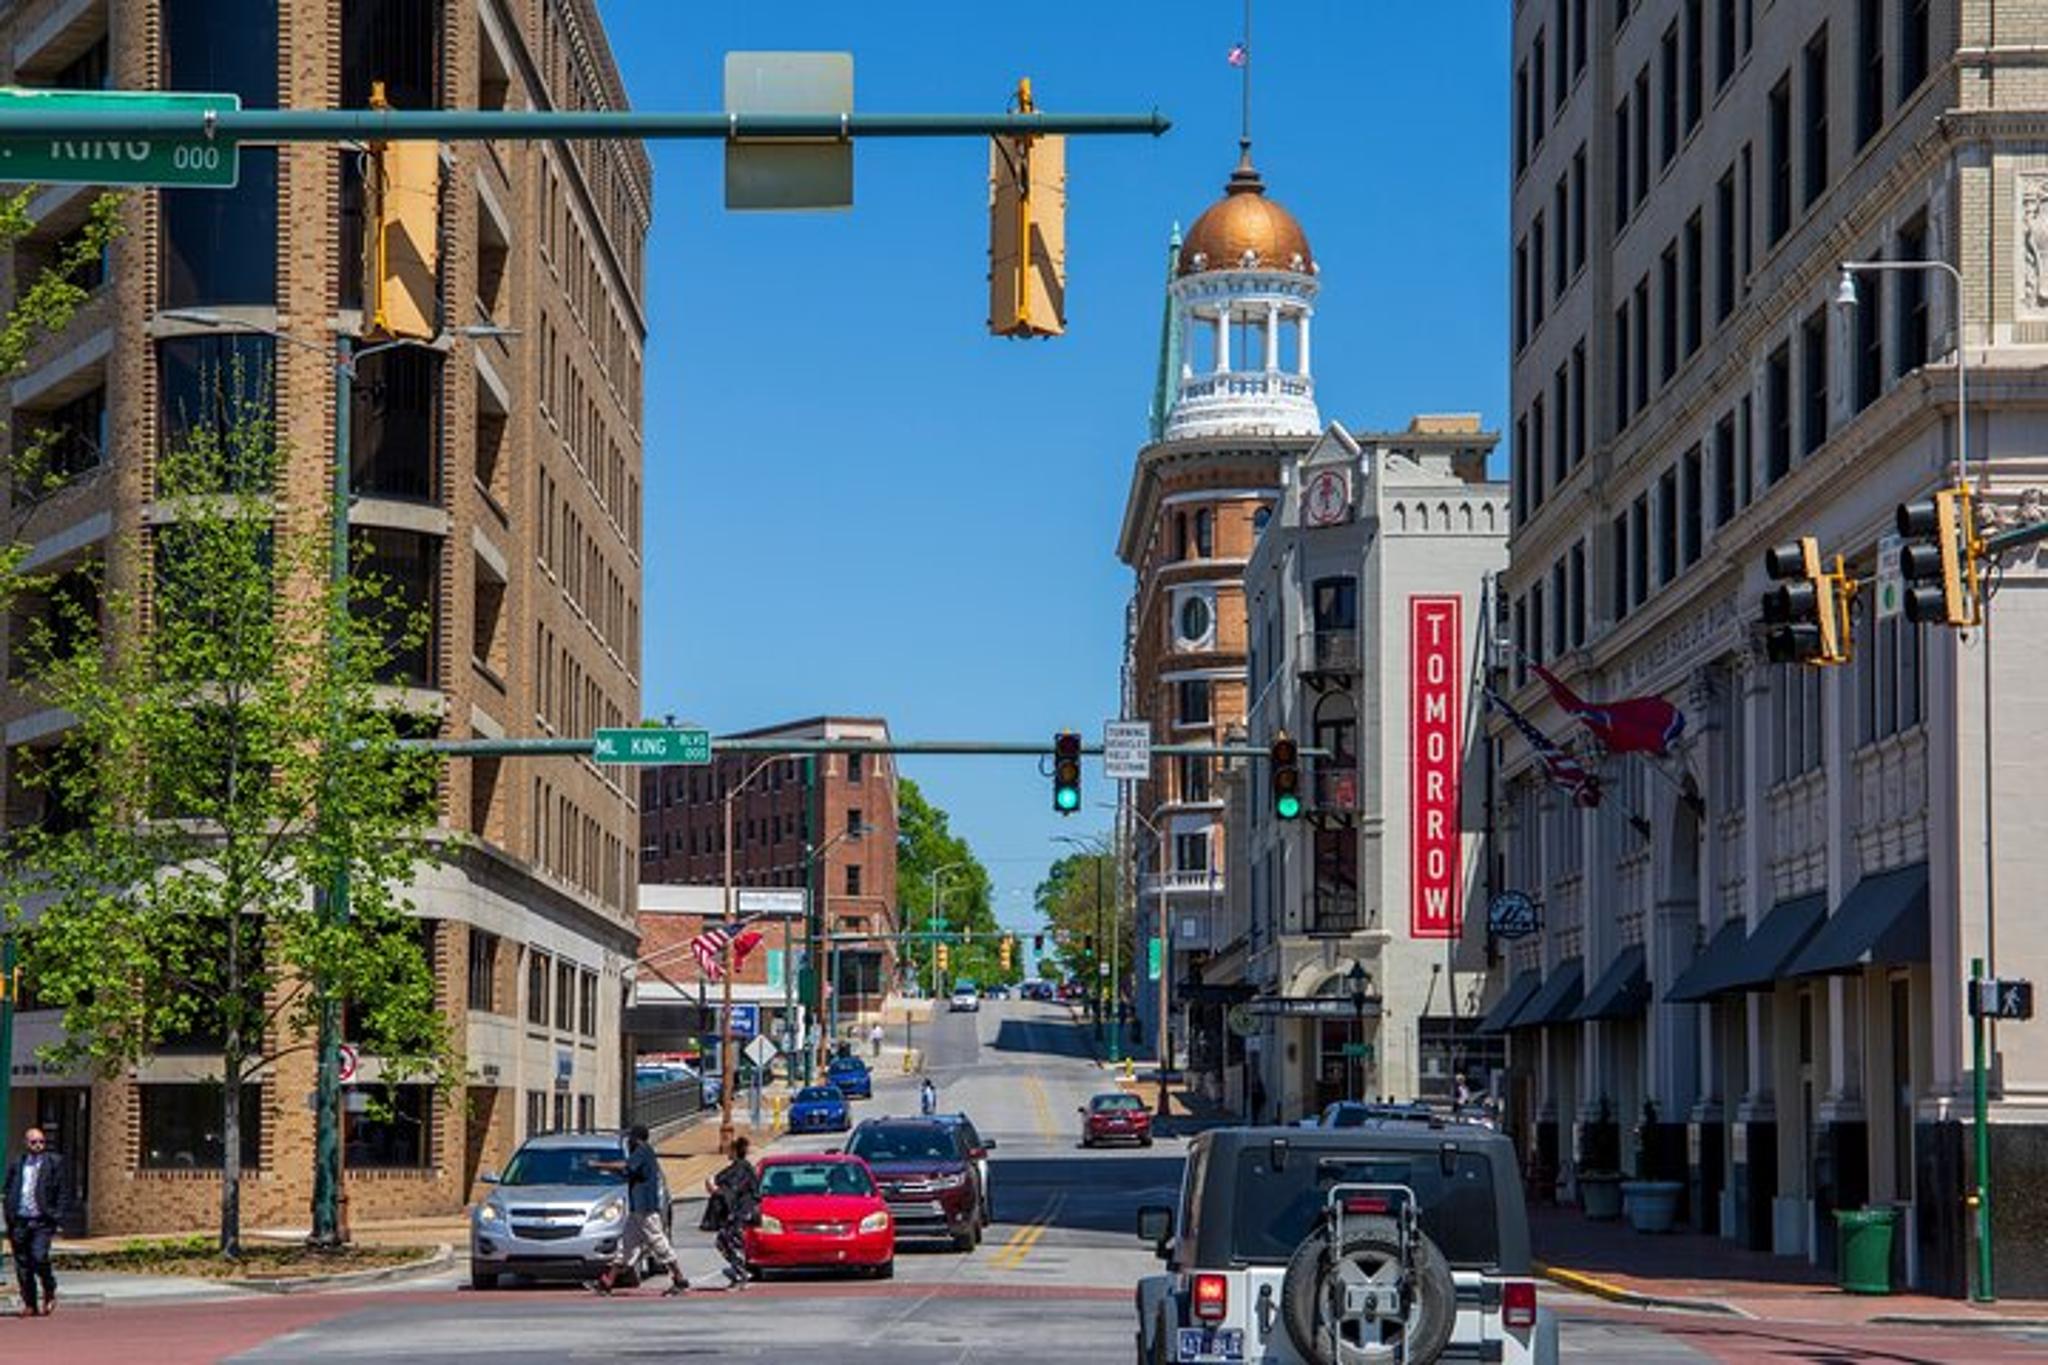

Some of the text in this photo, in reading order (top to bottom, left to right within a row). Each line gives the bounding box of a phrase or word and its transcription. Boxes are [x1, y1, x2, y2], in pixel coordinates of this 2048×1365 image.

[173, 146, 219, 169] 000
[631, 738, 667, 756] KING
[1425, 613, 1449, 919] TOMORROW
